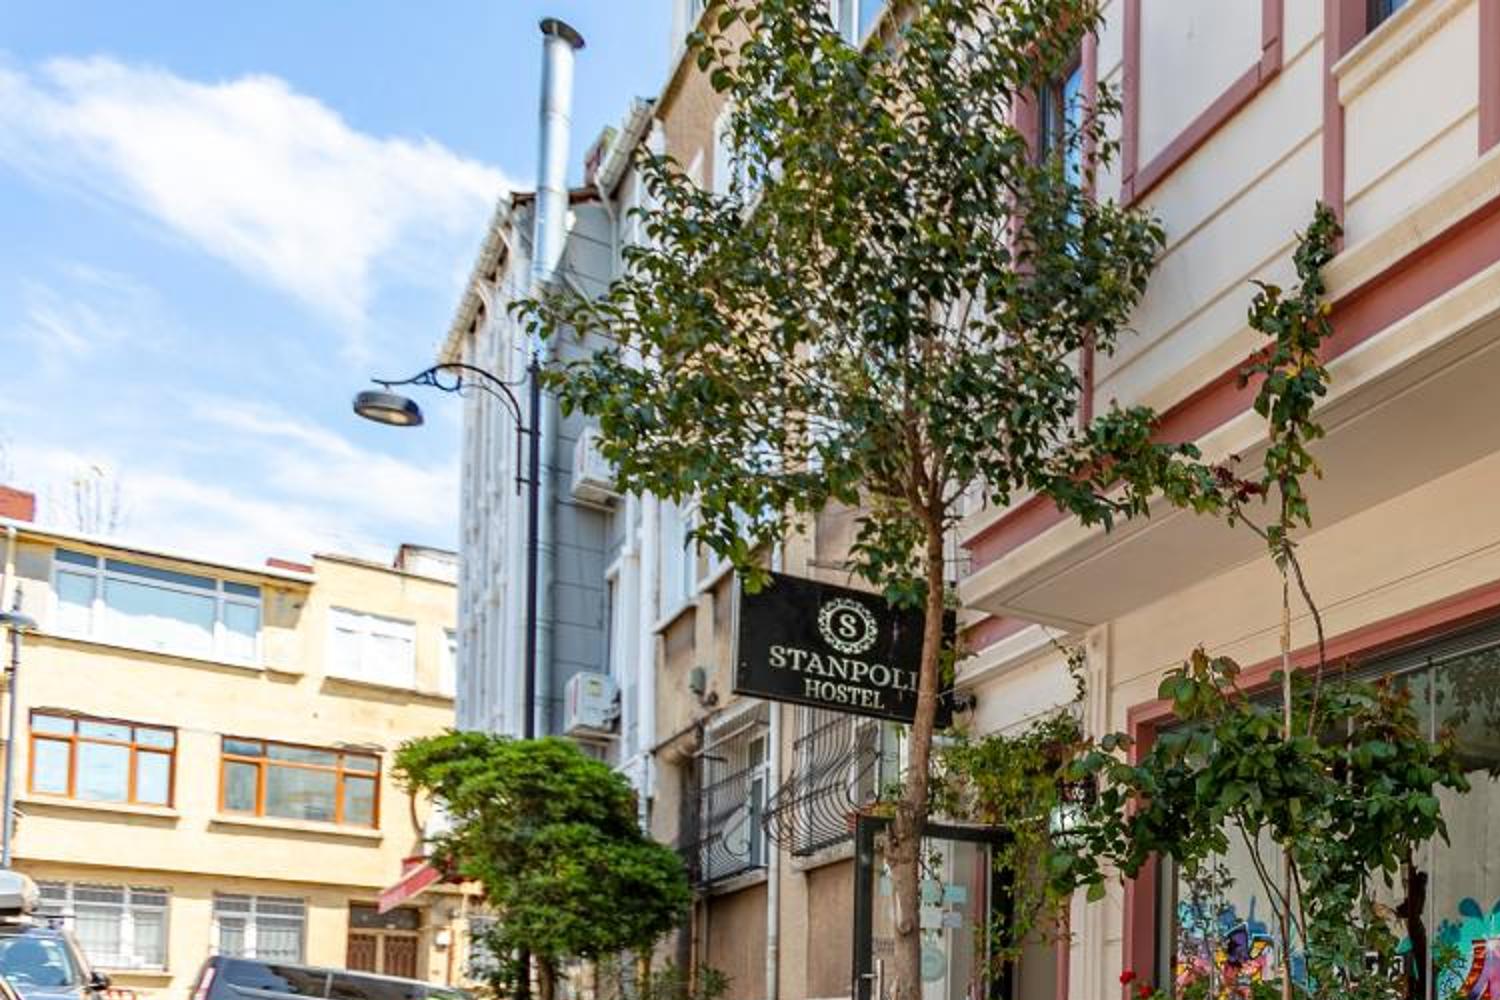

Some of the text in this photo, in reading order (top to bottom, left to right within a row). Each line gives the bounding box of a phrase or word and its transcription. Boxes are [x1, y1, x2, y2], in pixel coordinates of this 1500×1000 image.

[838, 614, 857, 637] S
[769, 646, 918, 691] STANPOLI
[804, 679, 885, 709] HOSTEL
